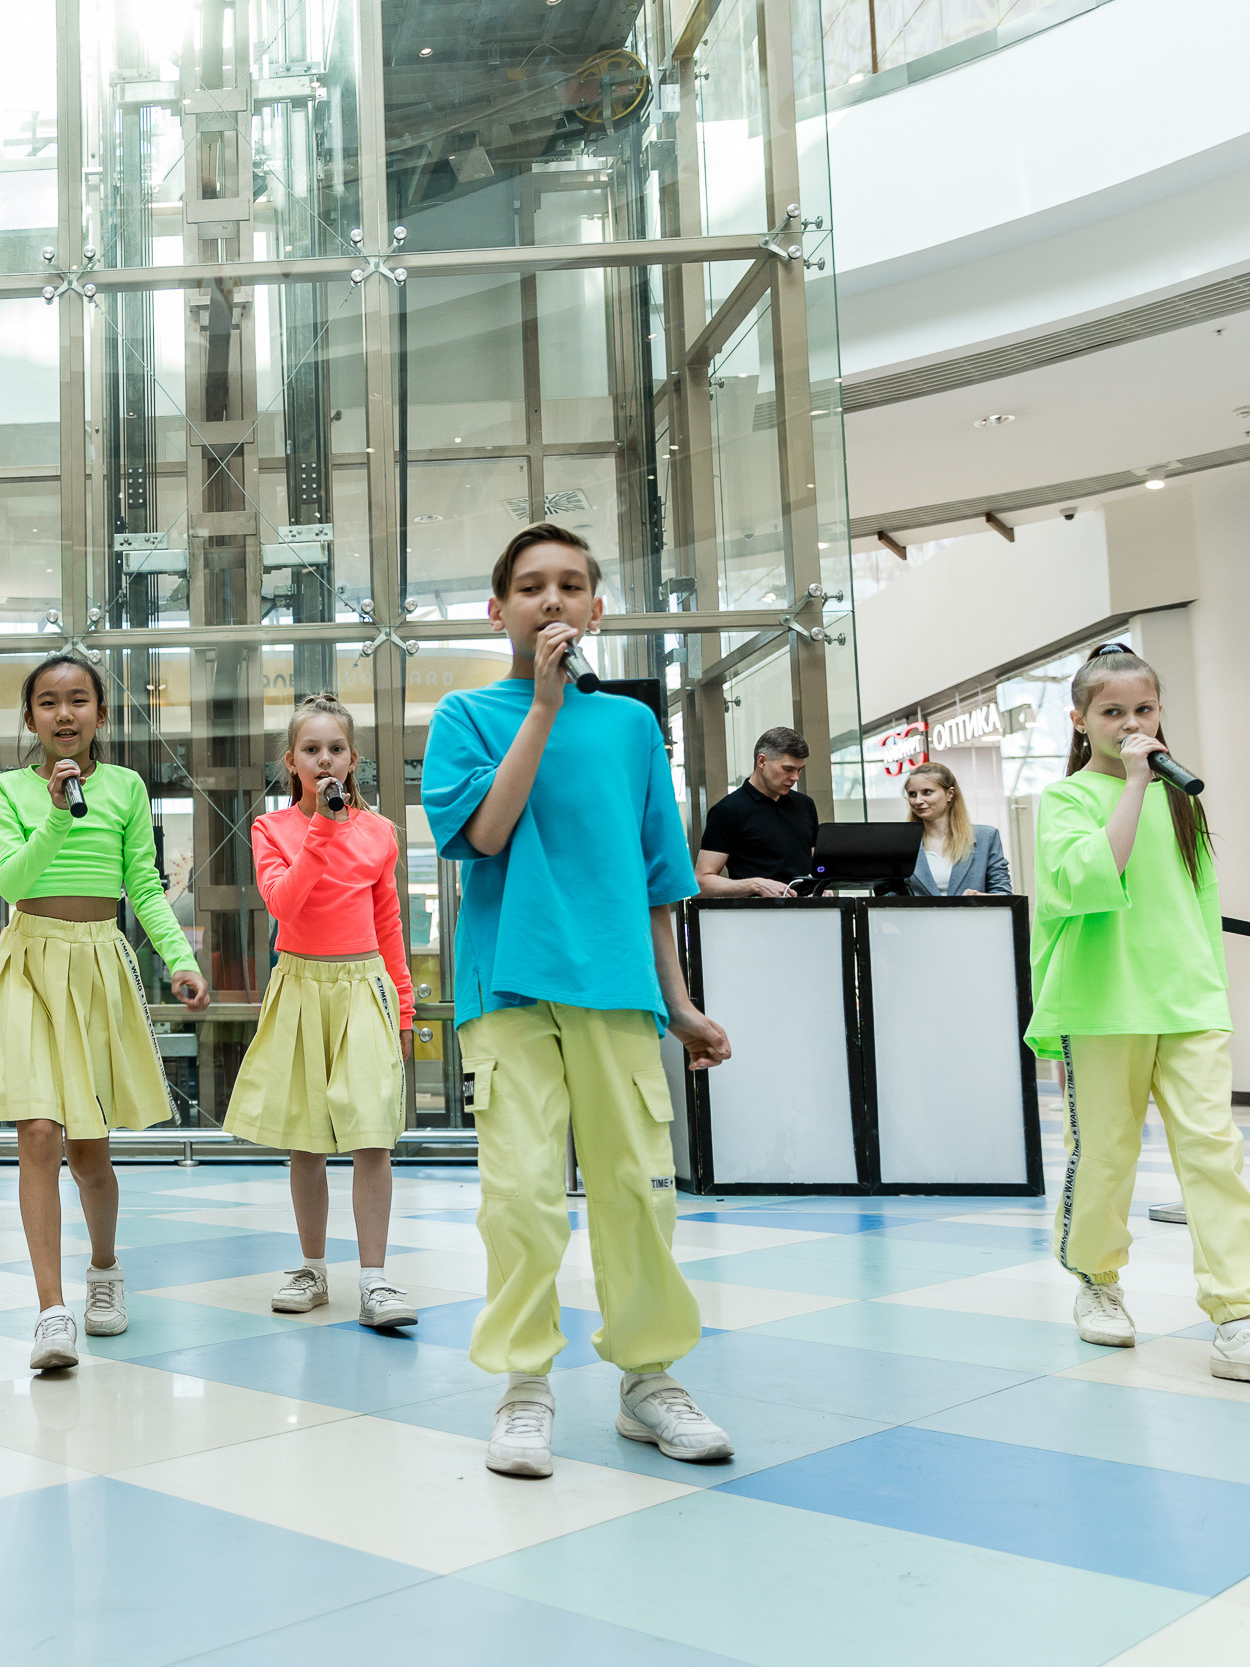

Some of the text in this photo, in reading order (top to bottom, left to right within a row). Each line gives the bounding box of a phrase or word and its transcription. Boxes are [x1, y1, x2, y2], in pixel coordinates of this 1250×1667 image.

[933, 703, 1002, 751] ОПТИКА
[119, 938, 131, 957] TIME
[131, 965, 143, 992] WANG
[378, 985, 388, 1003] TIME
[1067, 1069, 1075, 1090] TIME
[1068, 1101, 1078, 1128] WANG
[1072, 1138, 1080, 1158] TIME
[651, 1178, 669, 1188] TIME
[1064, 1167, 1075, 1193] WANG
[1063, 1200, 1072, 1221] TIME
[1060, 1229, 1069, 1254] WANG
